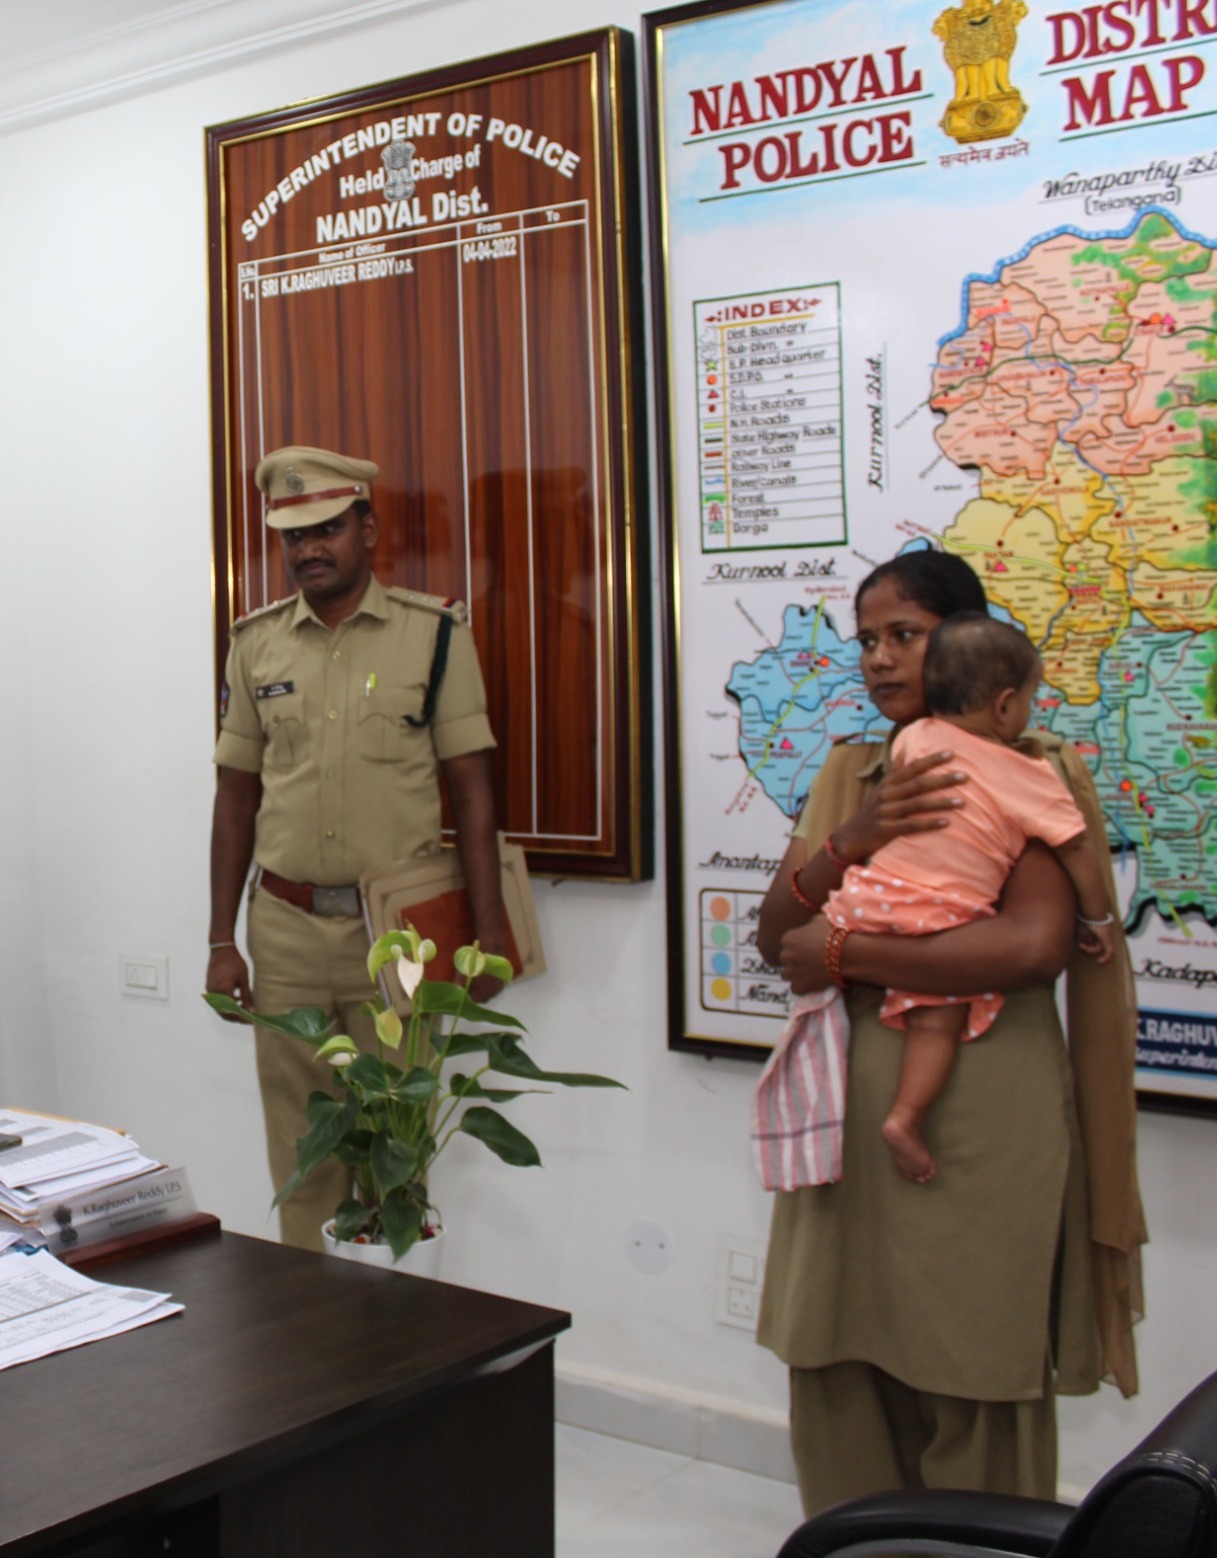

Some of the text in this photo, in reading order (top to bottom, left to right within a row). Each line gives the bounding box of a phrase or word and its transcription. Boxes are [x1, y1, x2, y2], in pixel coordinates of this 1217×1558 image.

[689, 45, 922, 136] NANDYAL
[719, 55, 1205, 190] POLICE MAP
[240, 112, 581, 242] SUPERINTENDENT OF POLICE
[339, 143, 481, 199] Held Charge of
[316, 185, 489, 244] NANDYAL Dist.
[476, 222, 502, 235] From
[546, 210, 560, 222] To
[261, 279, 279, 298] SRI
[280, 265, 357, 294] K.RAGHUVEER
[358, 257, 395, 281] REDDY
[463, 236, 517, 263] 04-04-2022
[724, 298, 803, 321] INDEX
